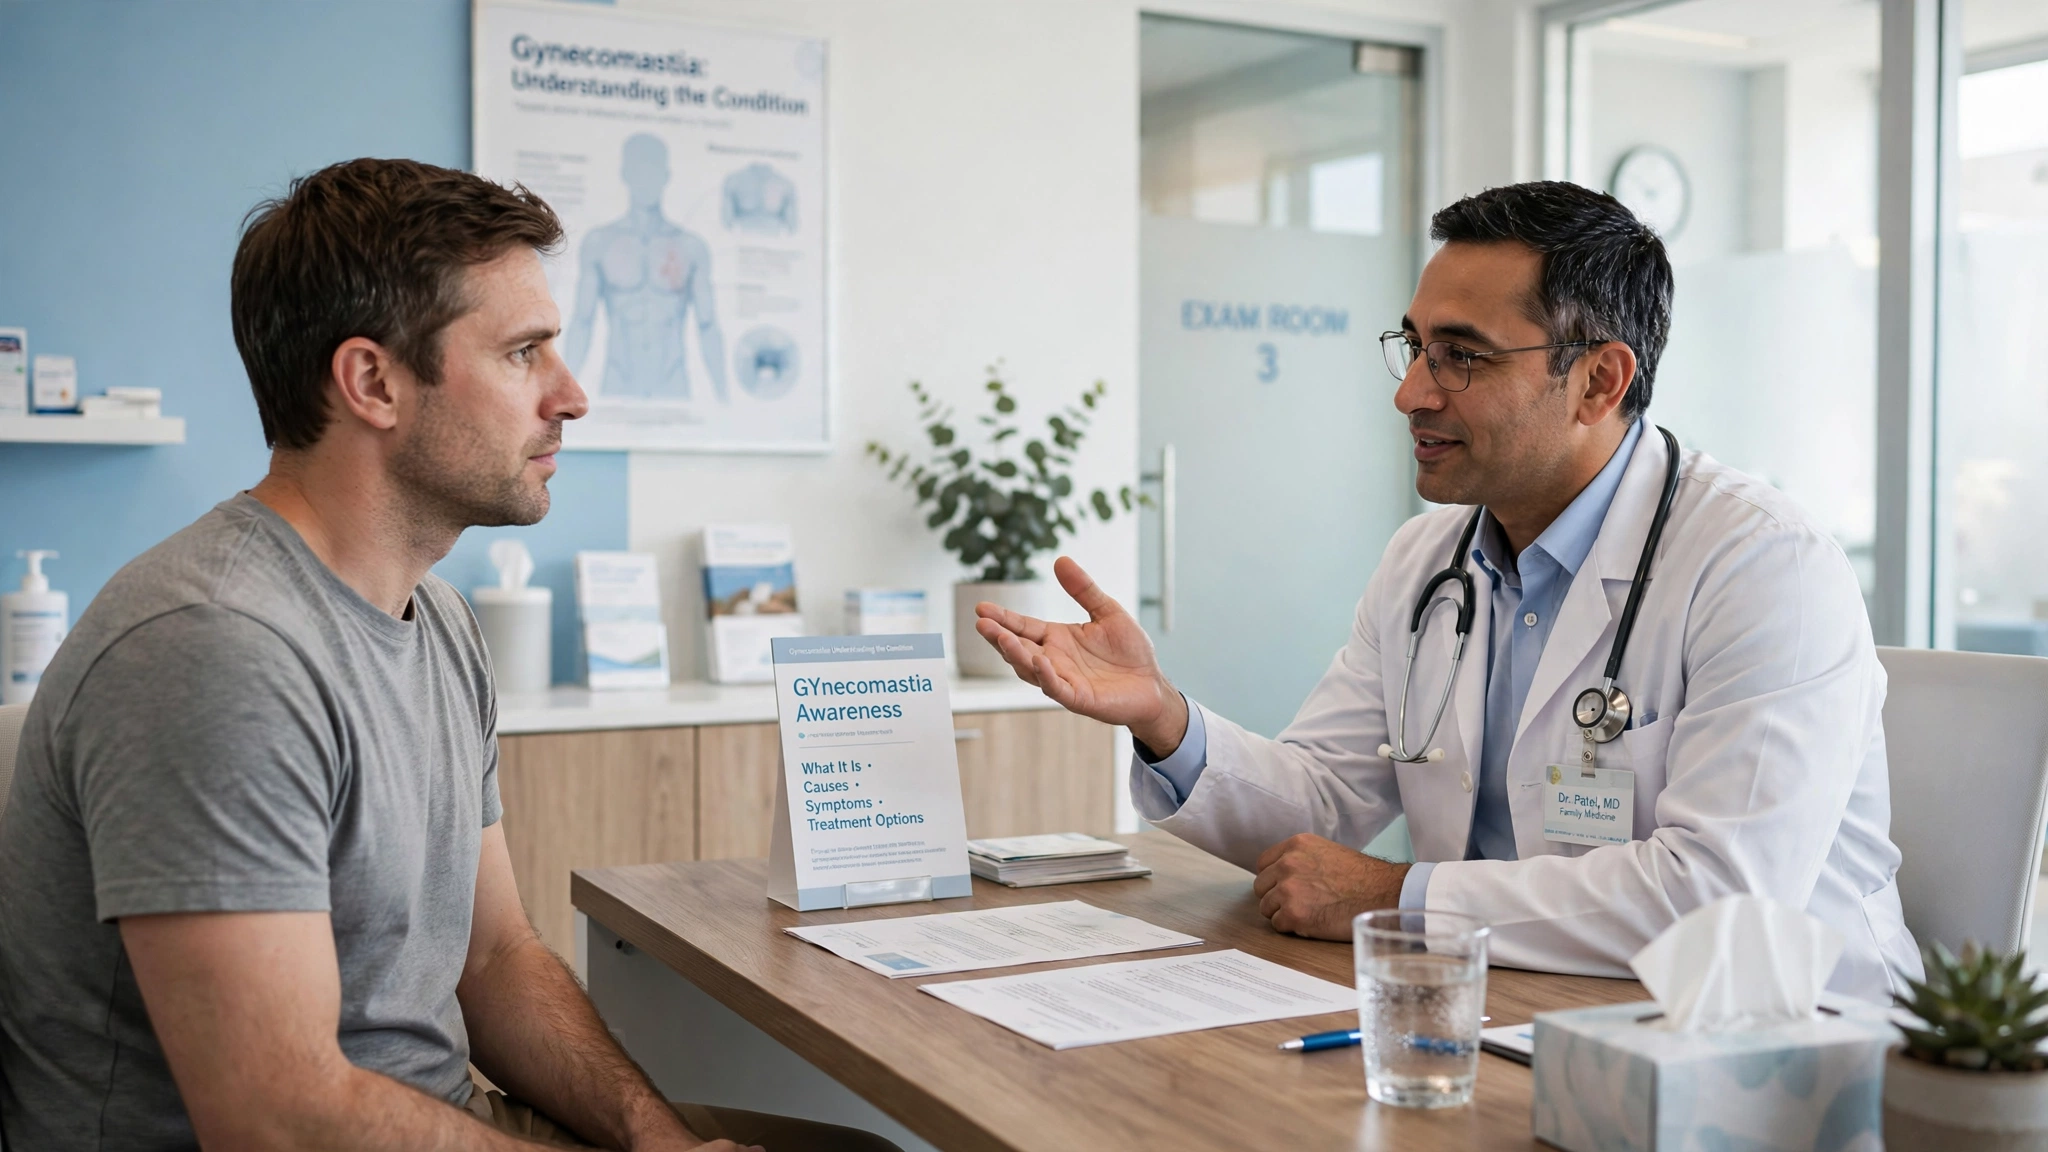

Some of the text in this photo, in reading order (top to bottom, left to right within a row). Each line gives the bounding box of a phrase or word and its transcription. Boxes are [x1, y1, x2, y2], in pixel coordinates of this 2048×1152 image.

[510, 34, 708, 77] Gynecomastia:
[511, 69, 669, 109] Understanding
[674, 85, 706, 106] the
[711, 86, 810, 115] Condition
[1180, 299, 1350, 336] EXAM ROOM
[1256, 342, 1280, 384] 3
[793, 674, 933, 697] GYnecomastia
[796, 703, 903, 723] Awareness
[801, 760, 862, 775] What It Is
[803, 781, 849, 793] Causes
[805, 798, 873, 815] Symptoms
[1603, 797, 1620, 810] MD
[807, 812, 925, 832] Treatment Options
[1559, 807, 1616, 822] Family Medicine
